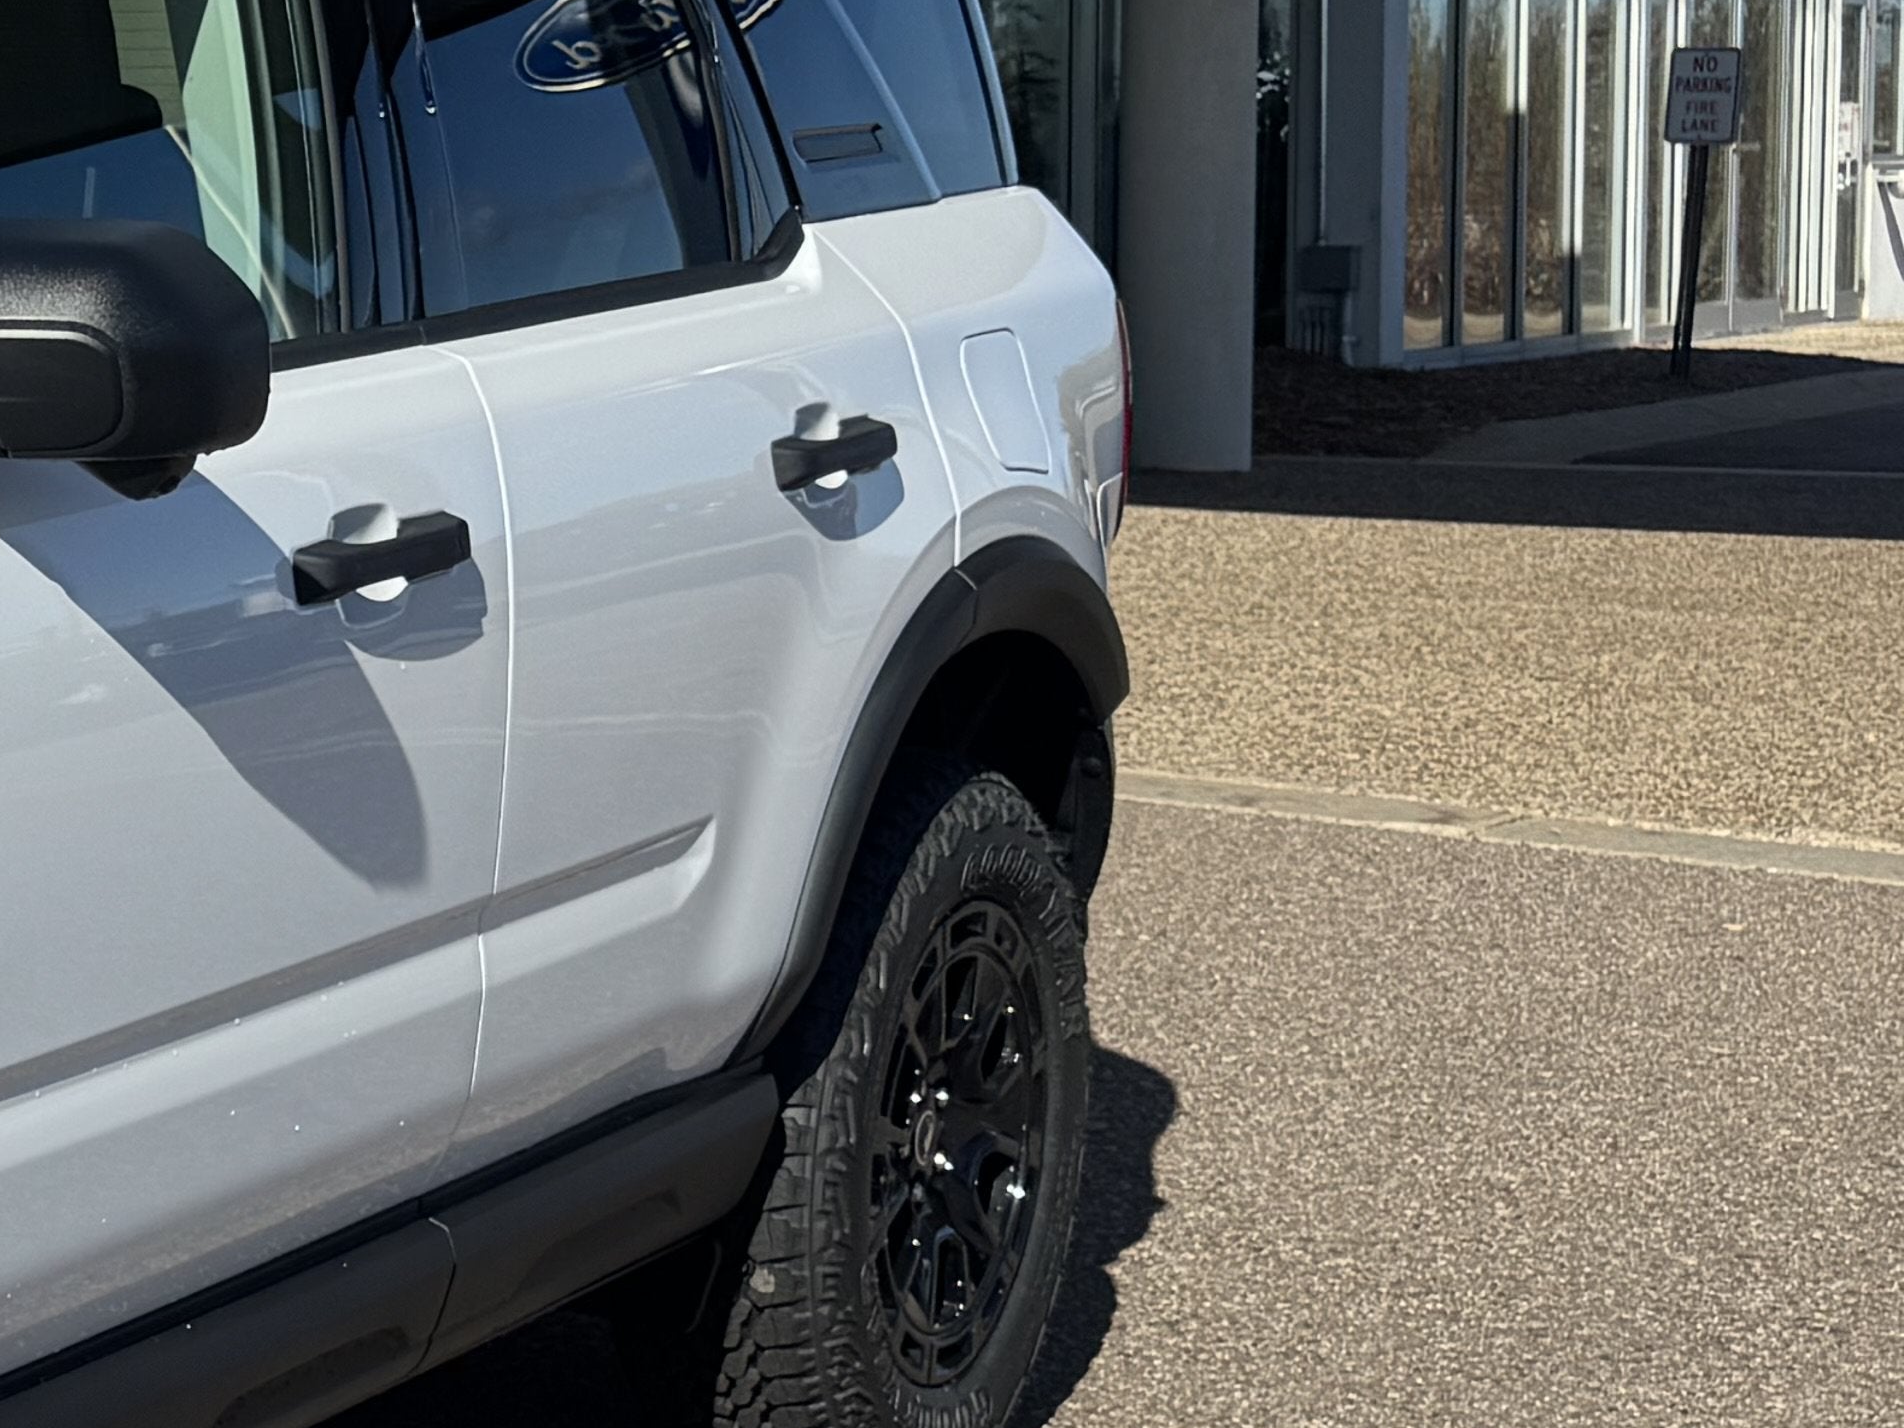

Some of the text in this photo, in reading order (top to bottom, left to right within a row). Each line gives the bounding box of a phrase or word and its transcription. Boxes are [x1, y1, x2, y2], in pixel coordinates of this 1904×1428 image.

[1693, 56, 1718, 72] NO
[1675, 76, 1732, 94] PARKING
[1686, 101, 1716, 115] FIRE
[1681, 119, 1717, 133] LANE
